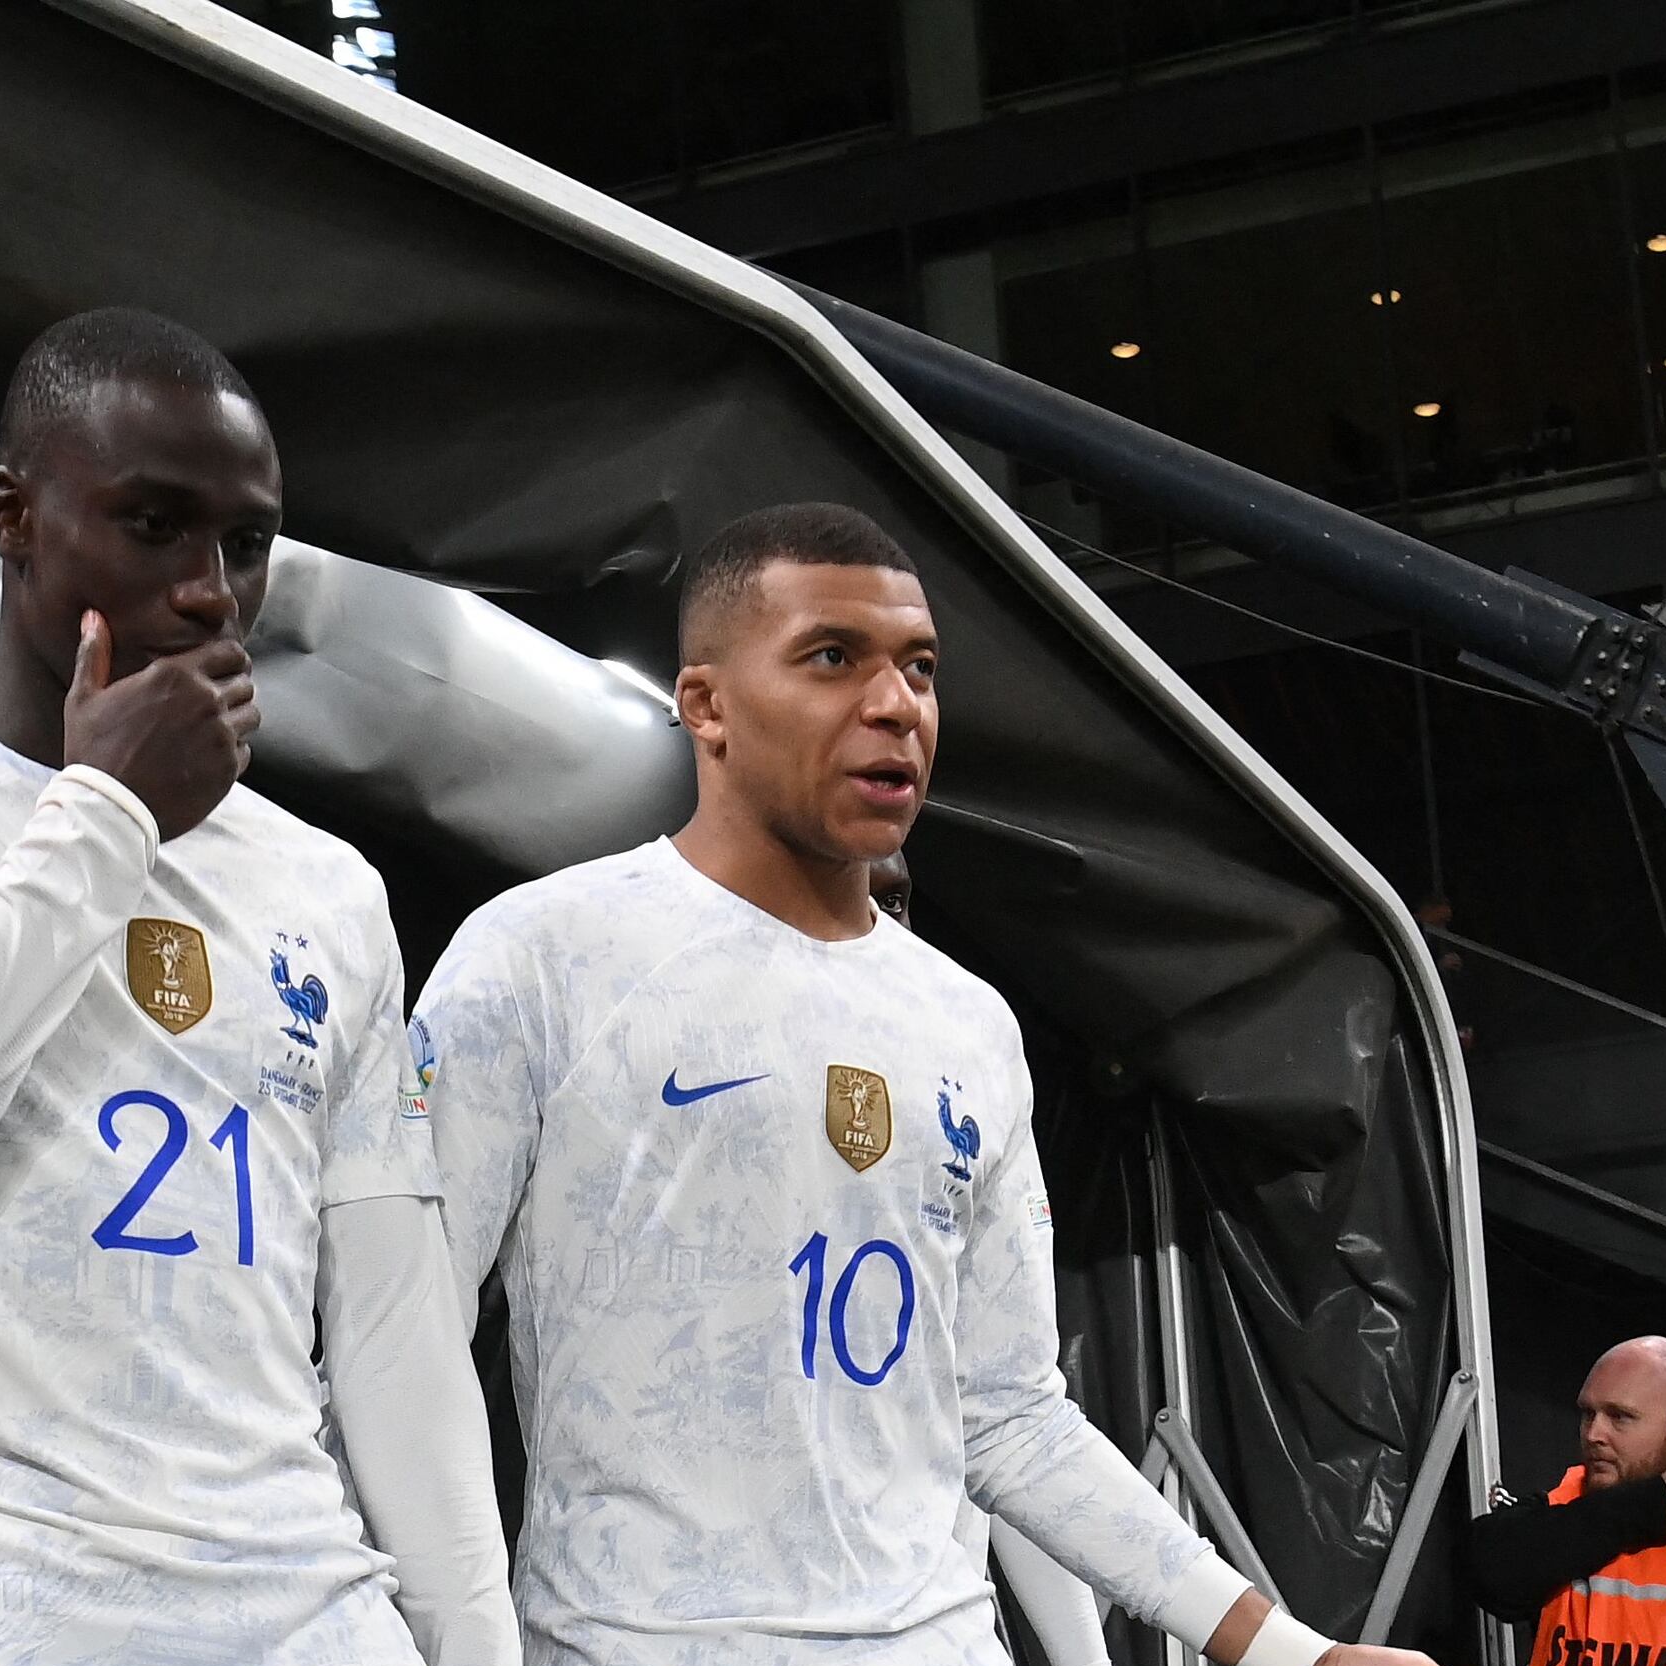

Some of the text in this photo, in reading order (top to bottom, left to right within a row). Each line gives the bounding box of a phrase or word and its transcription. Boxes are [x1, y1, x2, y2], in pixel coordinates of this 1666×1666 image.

[154, 989, 191, 1008] FIFA
[91, 1090, 253, 1266] 21
[845, 1130, 874, 1147] FIFA
[788, 1231, 915, 1386] 10
